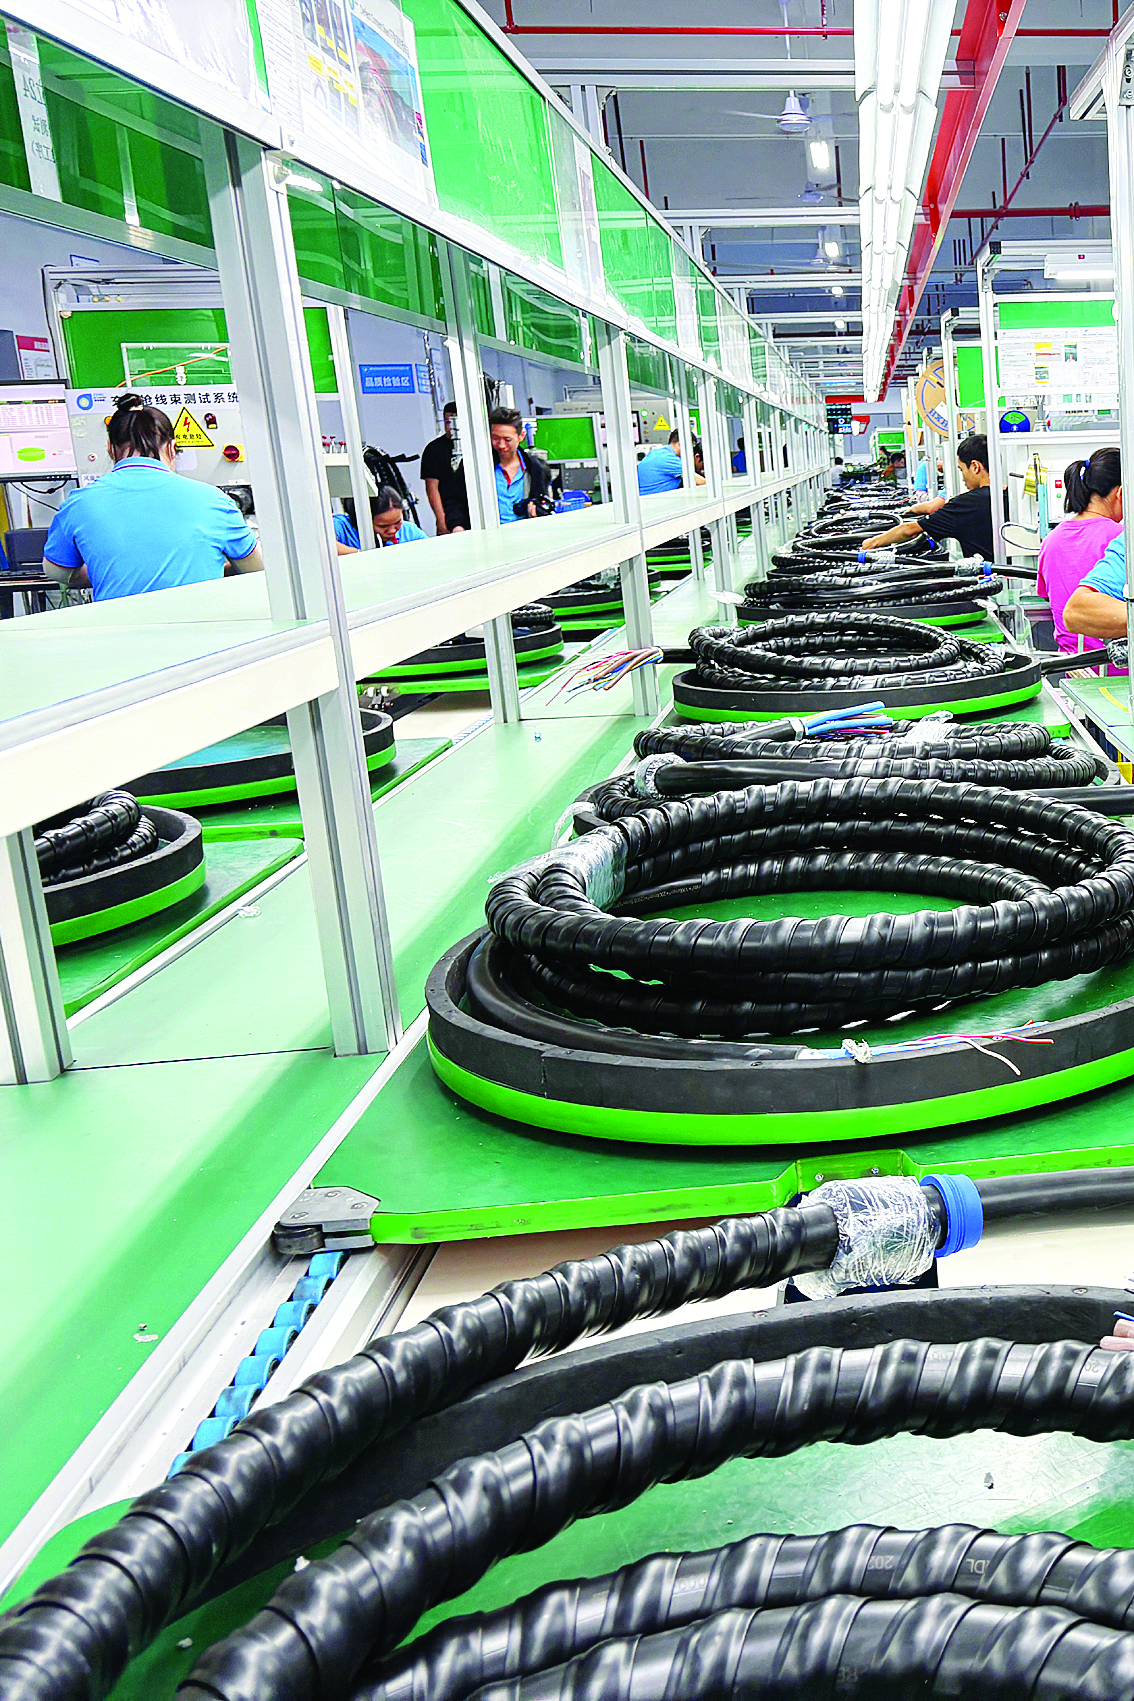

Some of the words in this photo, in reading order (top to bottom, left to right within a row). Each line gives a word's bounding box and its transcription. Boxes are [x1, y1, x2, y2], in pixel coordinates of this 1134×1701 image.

[365, 376, 410, 387] 品质检验区
